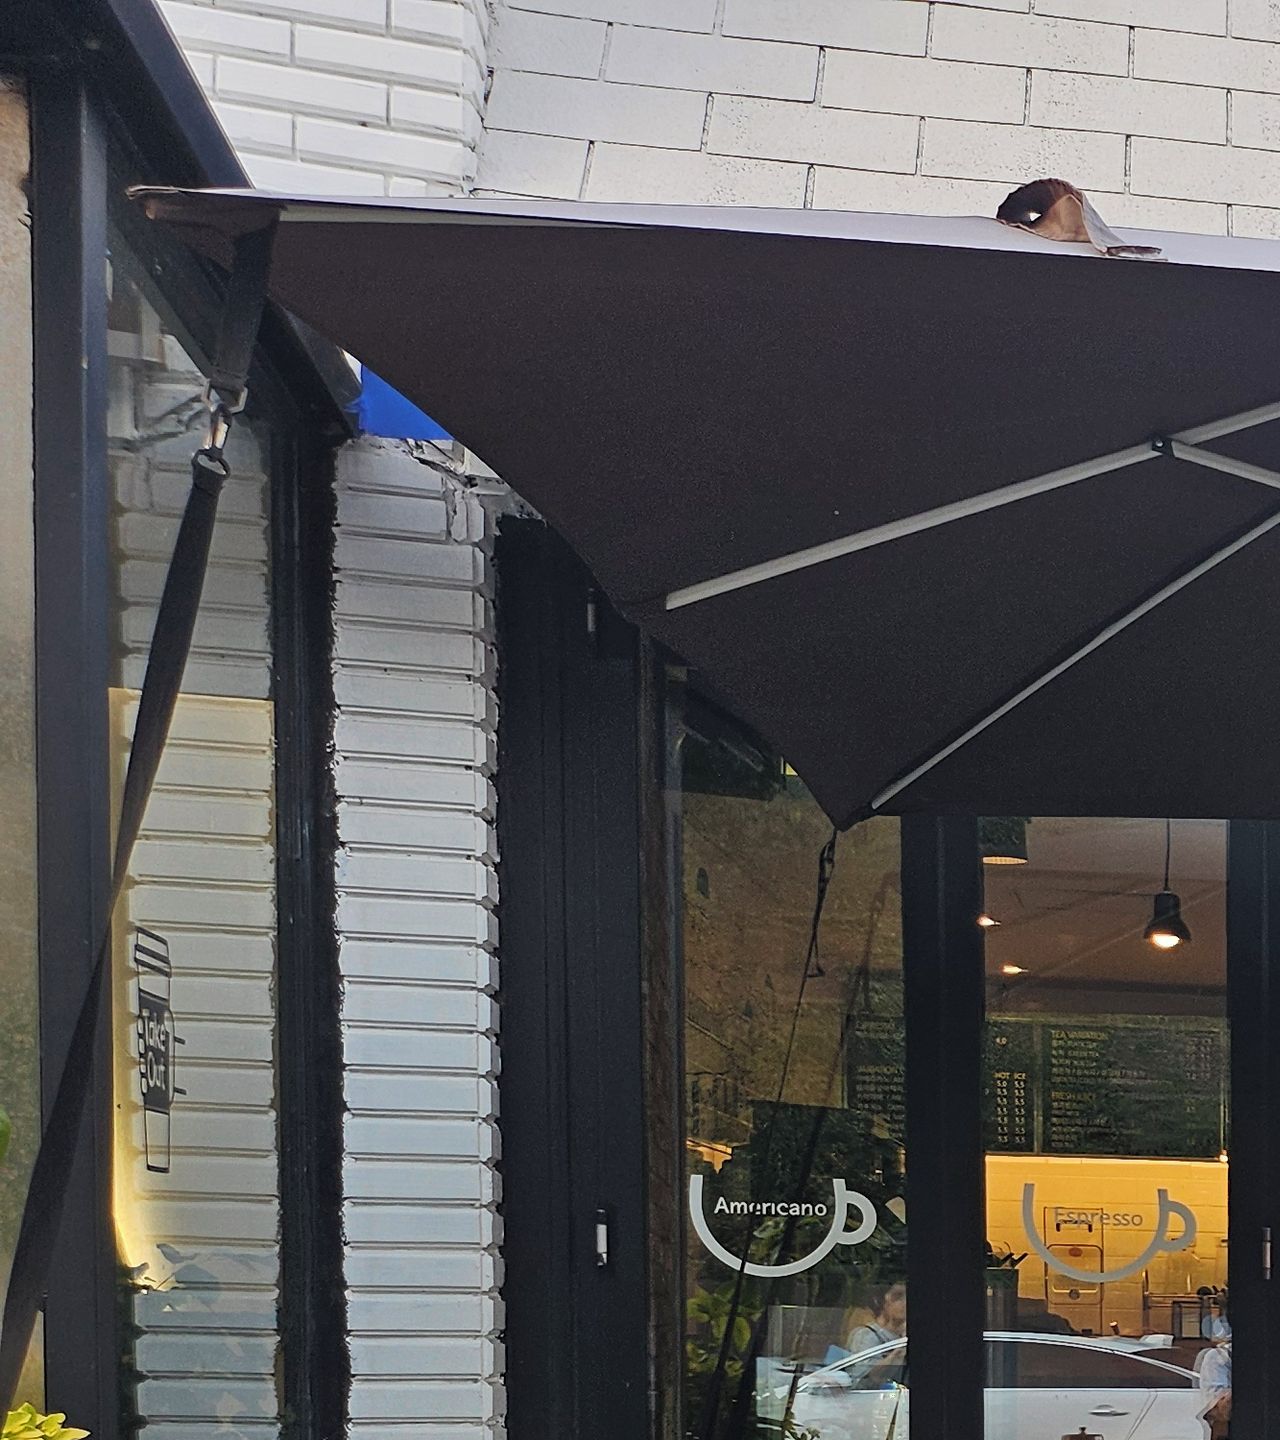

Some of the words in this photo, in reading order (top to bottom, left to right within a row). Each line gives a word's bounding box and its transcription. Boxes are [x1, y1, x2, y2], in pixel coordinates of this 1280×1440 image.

[141, 1008, 166, 1053] Take
[146, 1051, 166, 1091] Out
[714, 1196, 828, 1217] Americano
[1053, 1206, 1144, 1228] Espresso
